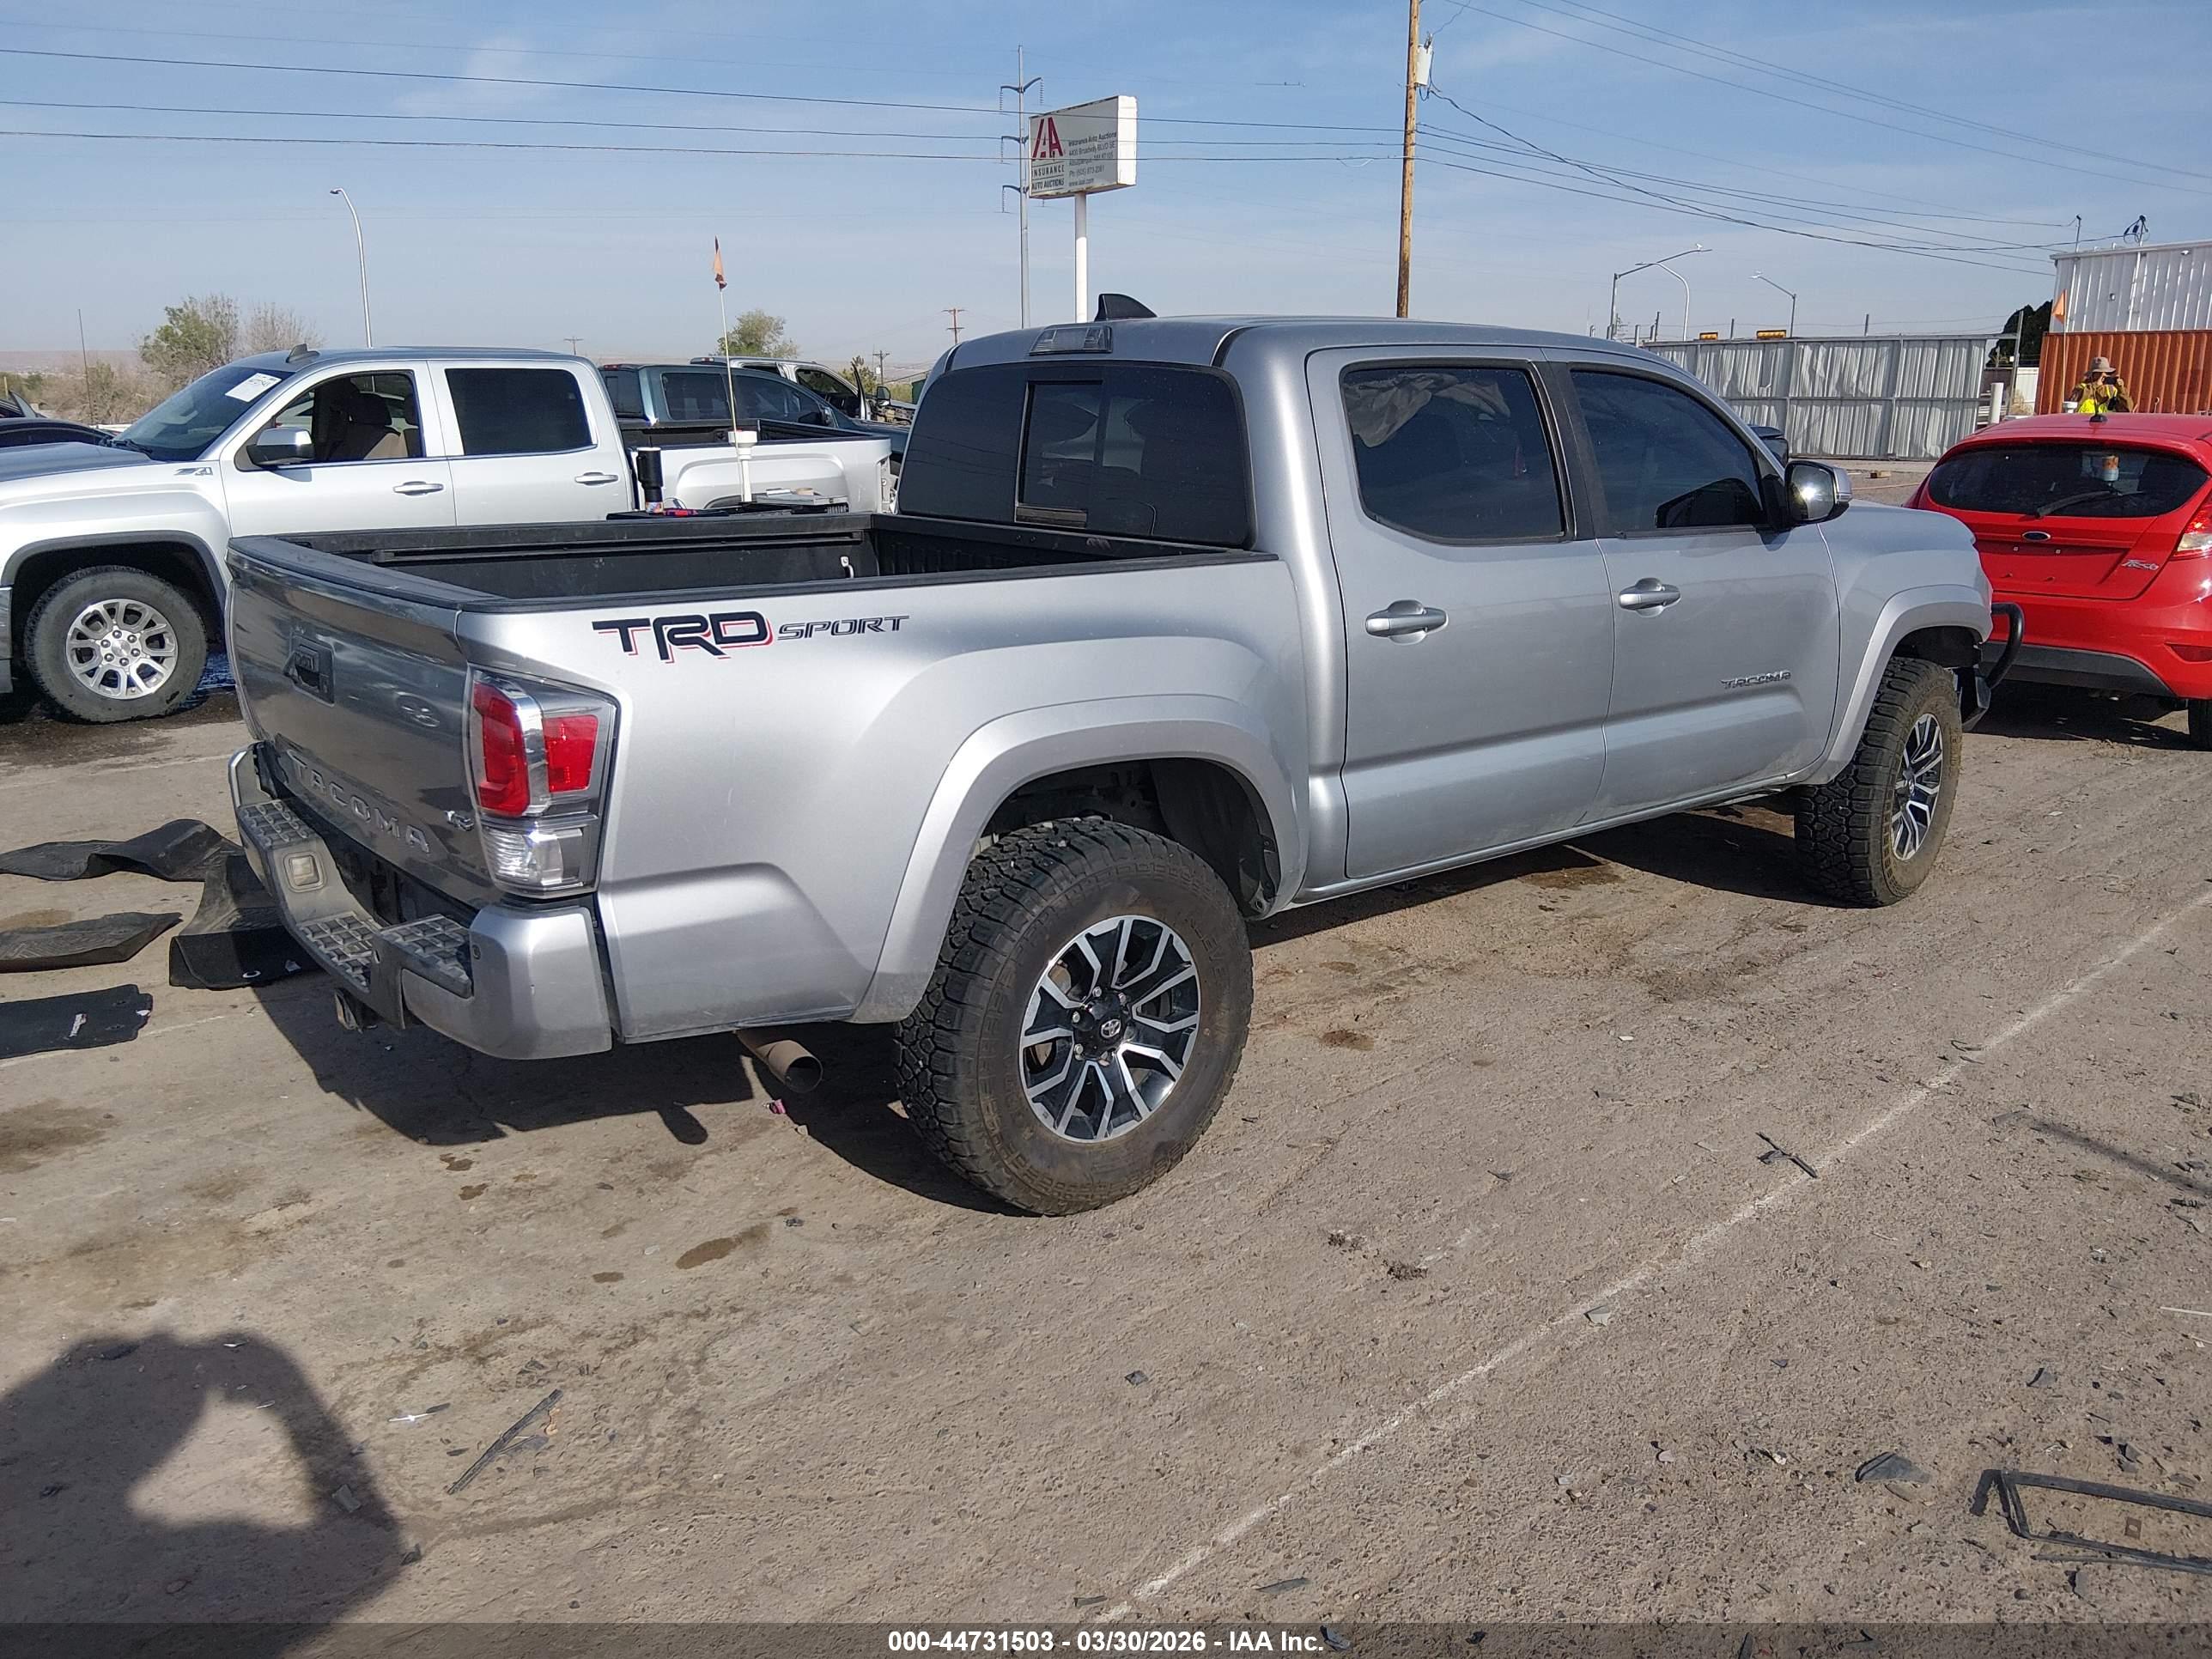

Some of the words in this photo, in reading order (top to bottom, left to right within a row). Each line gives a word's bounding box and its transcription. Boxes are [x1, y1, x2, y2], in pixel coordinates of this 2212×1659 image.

[1031, 164, 1065, 178] INSURANCE
[1031, 181, 1043, 191] AUTO
[1043, 178, 1065, 189] AUCTIONS
[592, 611, 774, 664] TRD
[777, 615, 910, 641] SPORT
[1720, 670, 1791, 689] TACOMA
[286, 749, 431, 854] TACOMA
